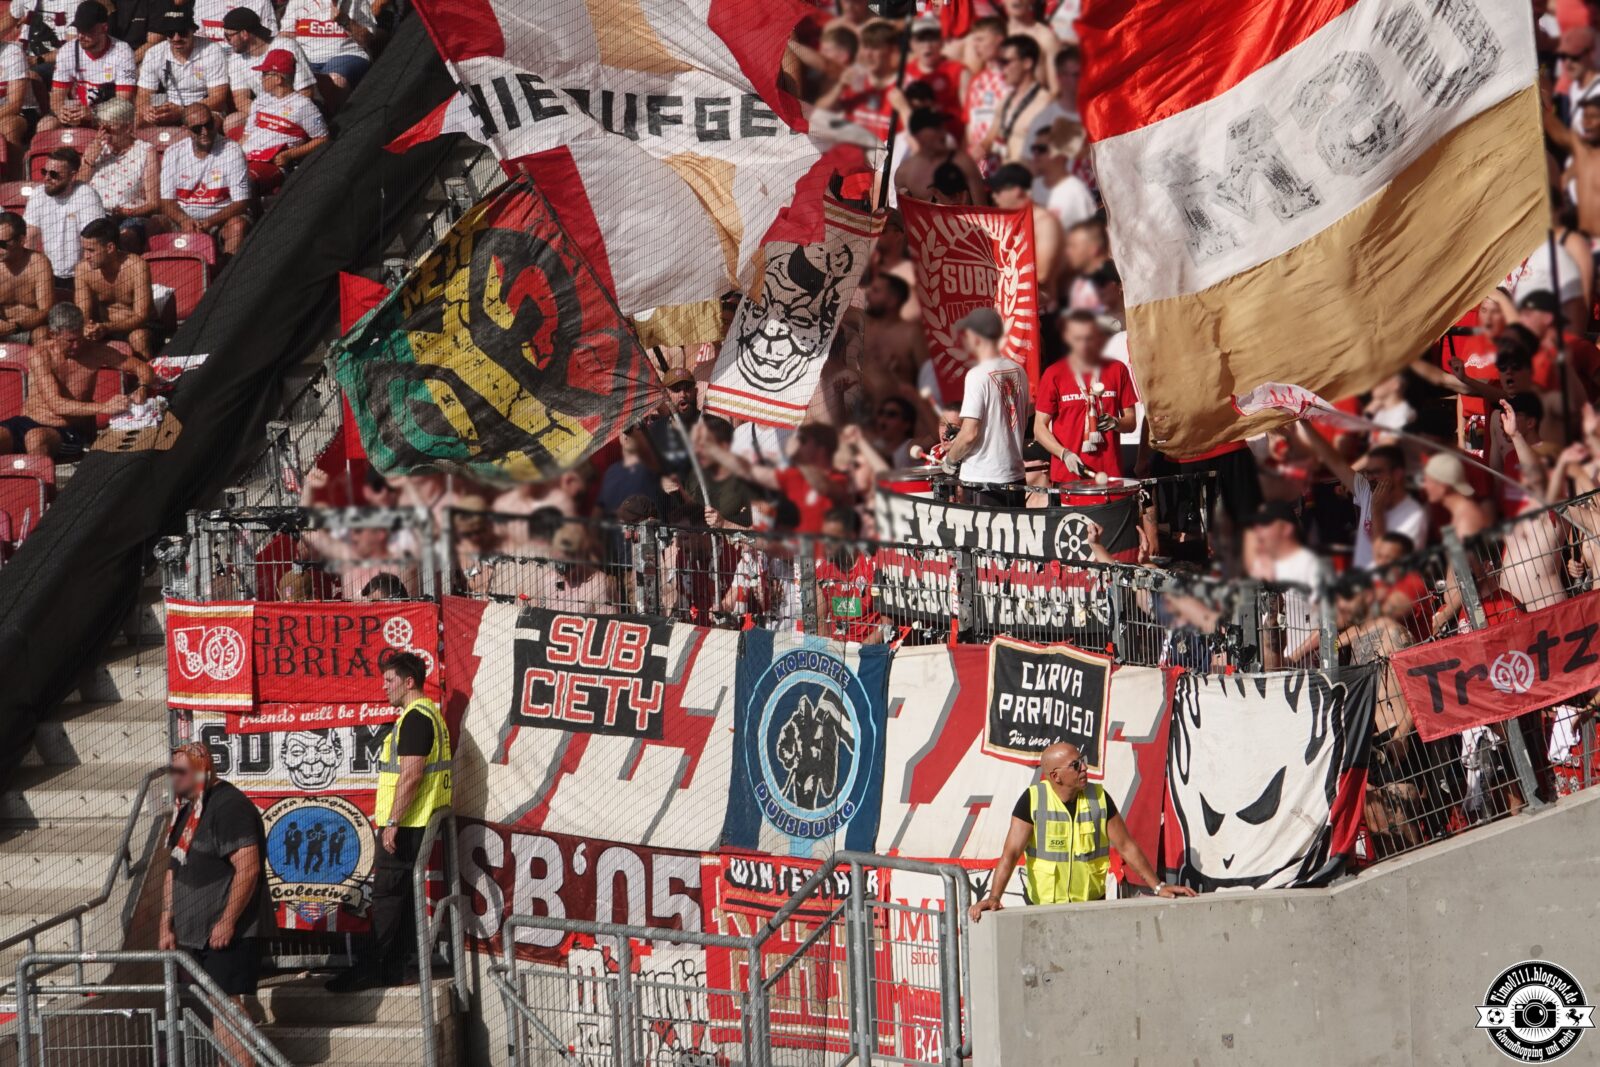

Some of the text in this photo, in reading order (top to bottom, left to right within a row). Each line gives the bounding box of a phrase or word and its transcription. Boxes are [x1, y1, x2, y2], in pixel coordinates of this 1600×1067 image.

[546, 614, 651, 673] SUB
[773, 652, 850, 690] KOHORTE
[1021, 661, 1083, 698] CURVA
[300, 706, 334, 722] will
[337, 703, 355, 719] be
[520, 667, 664, 731] CIETY
[999, 692, 1094, 738] PARADISO
[1008, 729, 1026, 746] Für
[754, 780, 855, 837] DUISBURG
[271, 884, 353, 901] Colectivo
